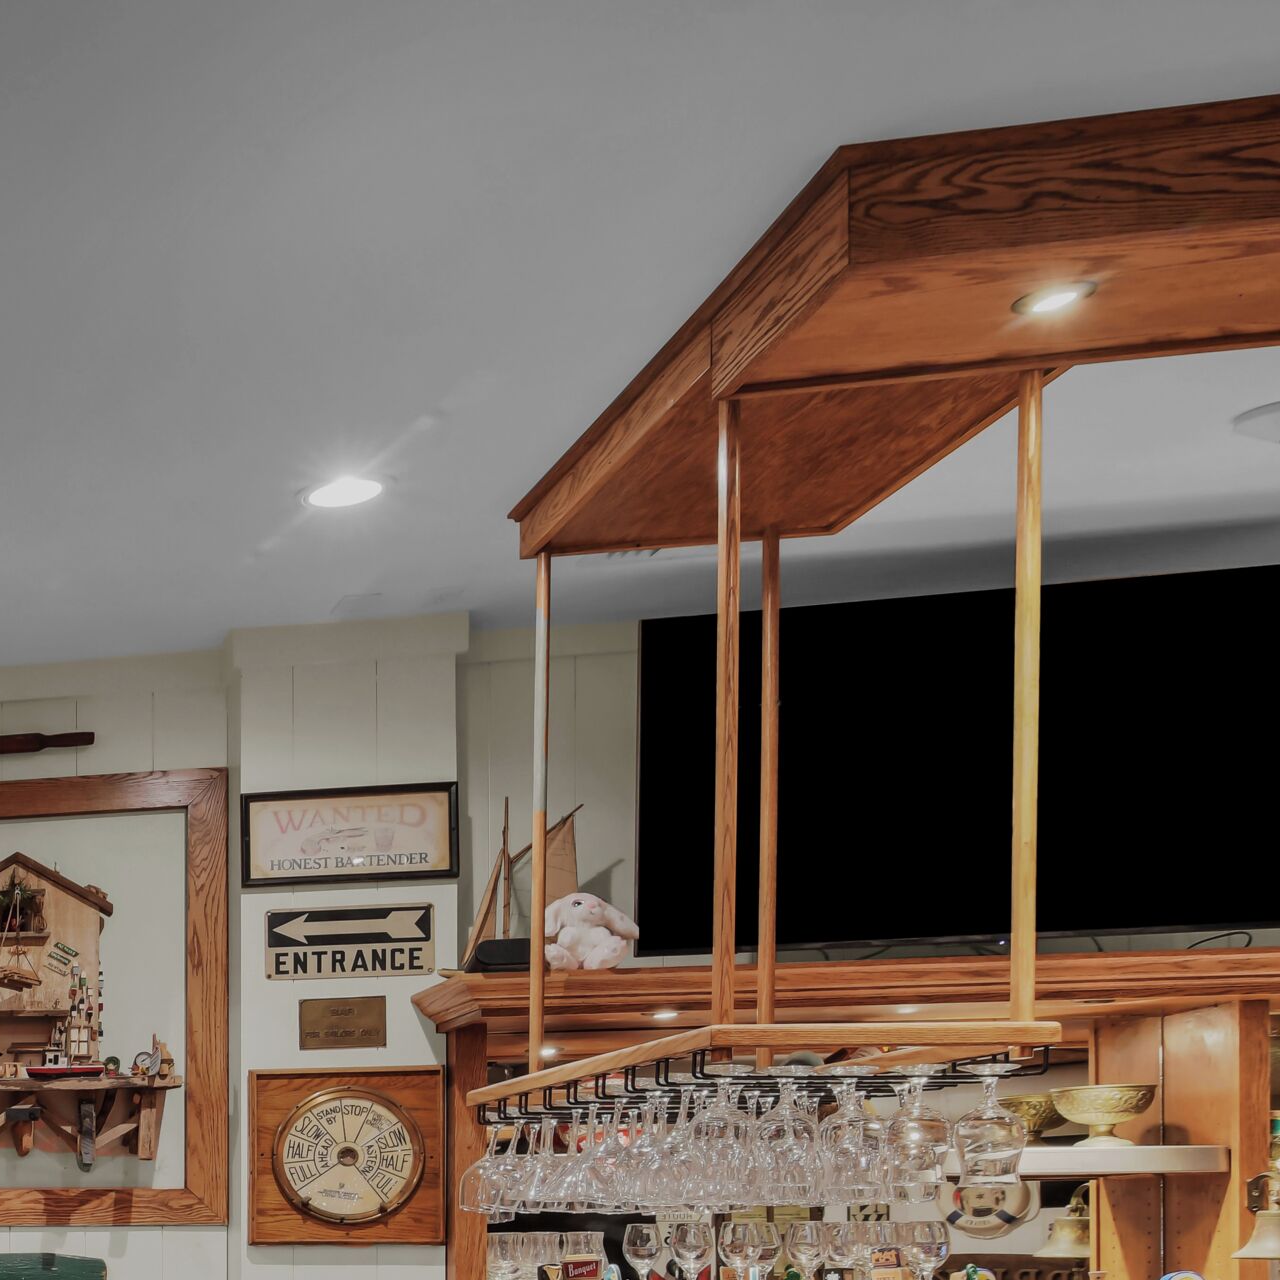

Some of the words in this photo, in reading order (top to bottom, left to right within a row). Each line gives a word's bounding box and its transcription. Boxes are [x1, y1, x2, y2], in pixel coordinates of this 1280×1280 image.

[272, 803, 428, 834] WANTED
[270, 857, 331, 871] HONEST
[274, 946, 424, 976] ENTRANCE
[316, 1105, 341, 1120] STAND
[325, 1115, 337, 1126] BY
[343, 1104, 369, 1117] STOP
[294, 1115, 325, 1141] SLOW
[377, 1125, 408, 1150] SLOW
[286, 1138, 315, 1160] HALF
[317, 1137, 334, 1169] AHEAD
[361, 1143, 378, 1177] ASTERN
[288, 1163, 317, 1186] FULL
[381, 1153, 412, 1173] HALF
[371, 1171, 399, 1200] FULL
[567, 1262, 597, 1279] Banquet
